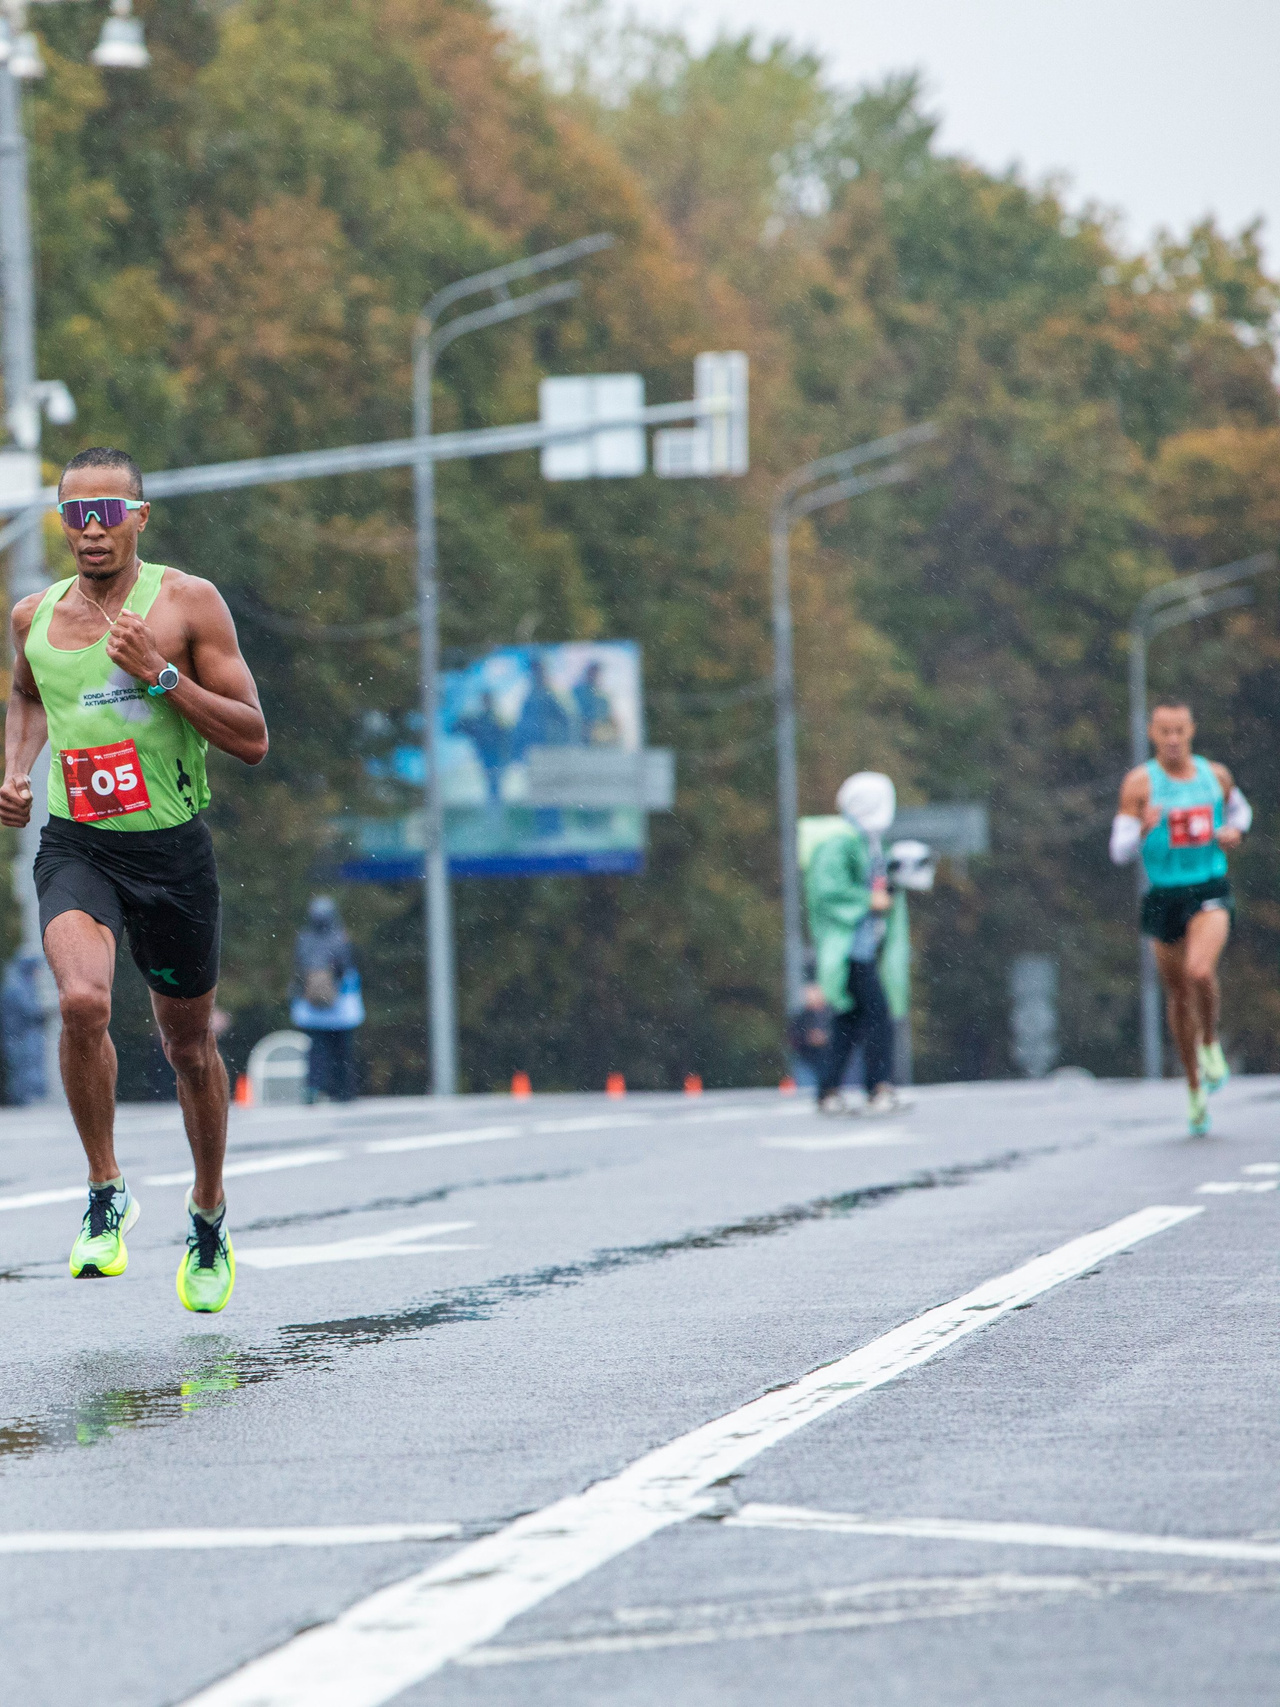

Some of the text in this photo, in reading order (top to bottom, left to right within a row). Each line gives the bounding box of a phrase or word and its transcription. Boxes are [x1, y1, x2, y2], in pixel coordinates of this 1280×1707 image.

[83, 692, 105, 700] KONDA
[85, 697, 119, 706] АКТИВНОЙ
[91, 763, 138, 796] 05
